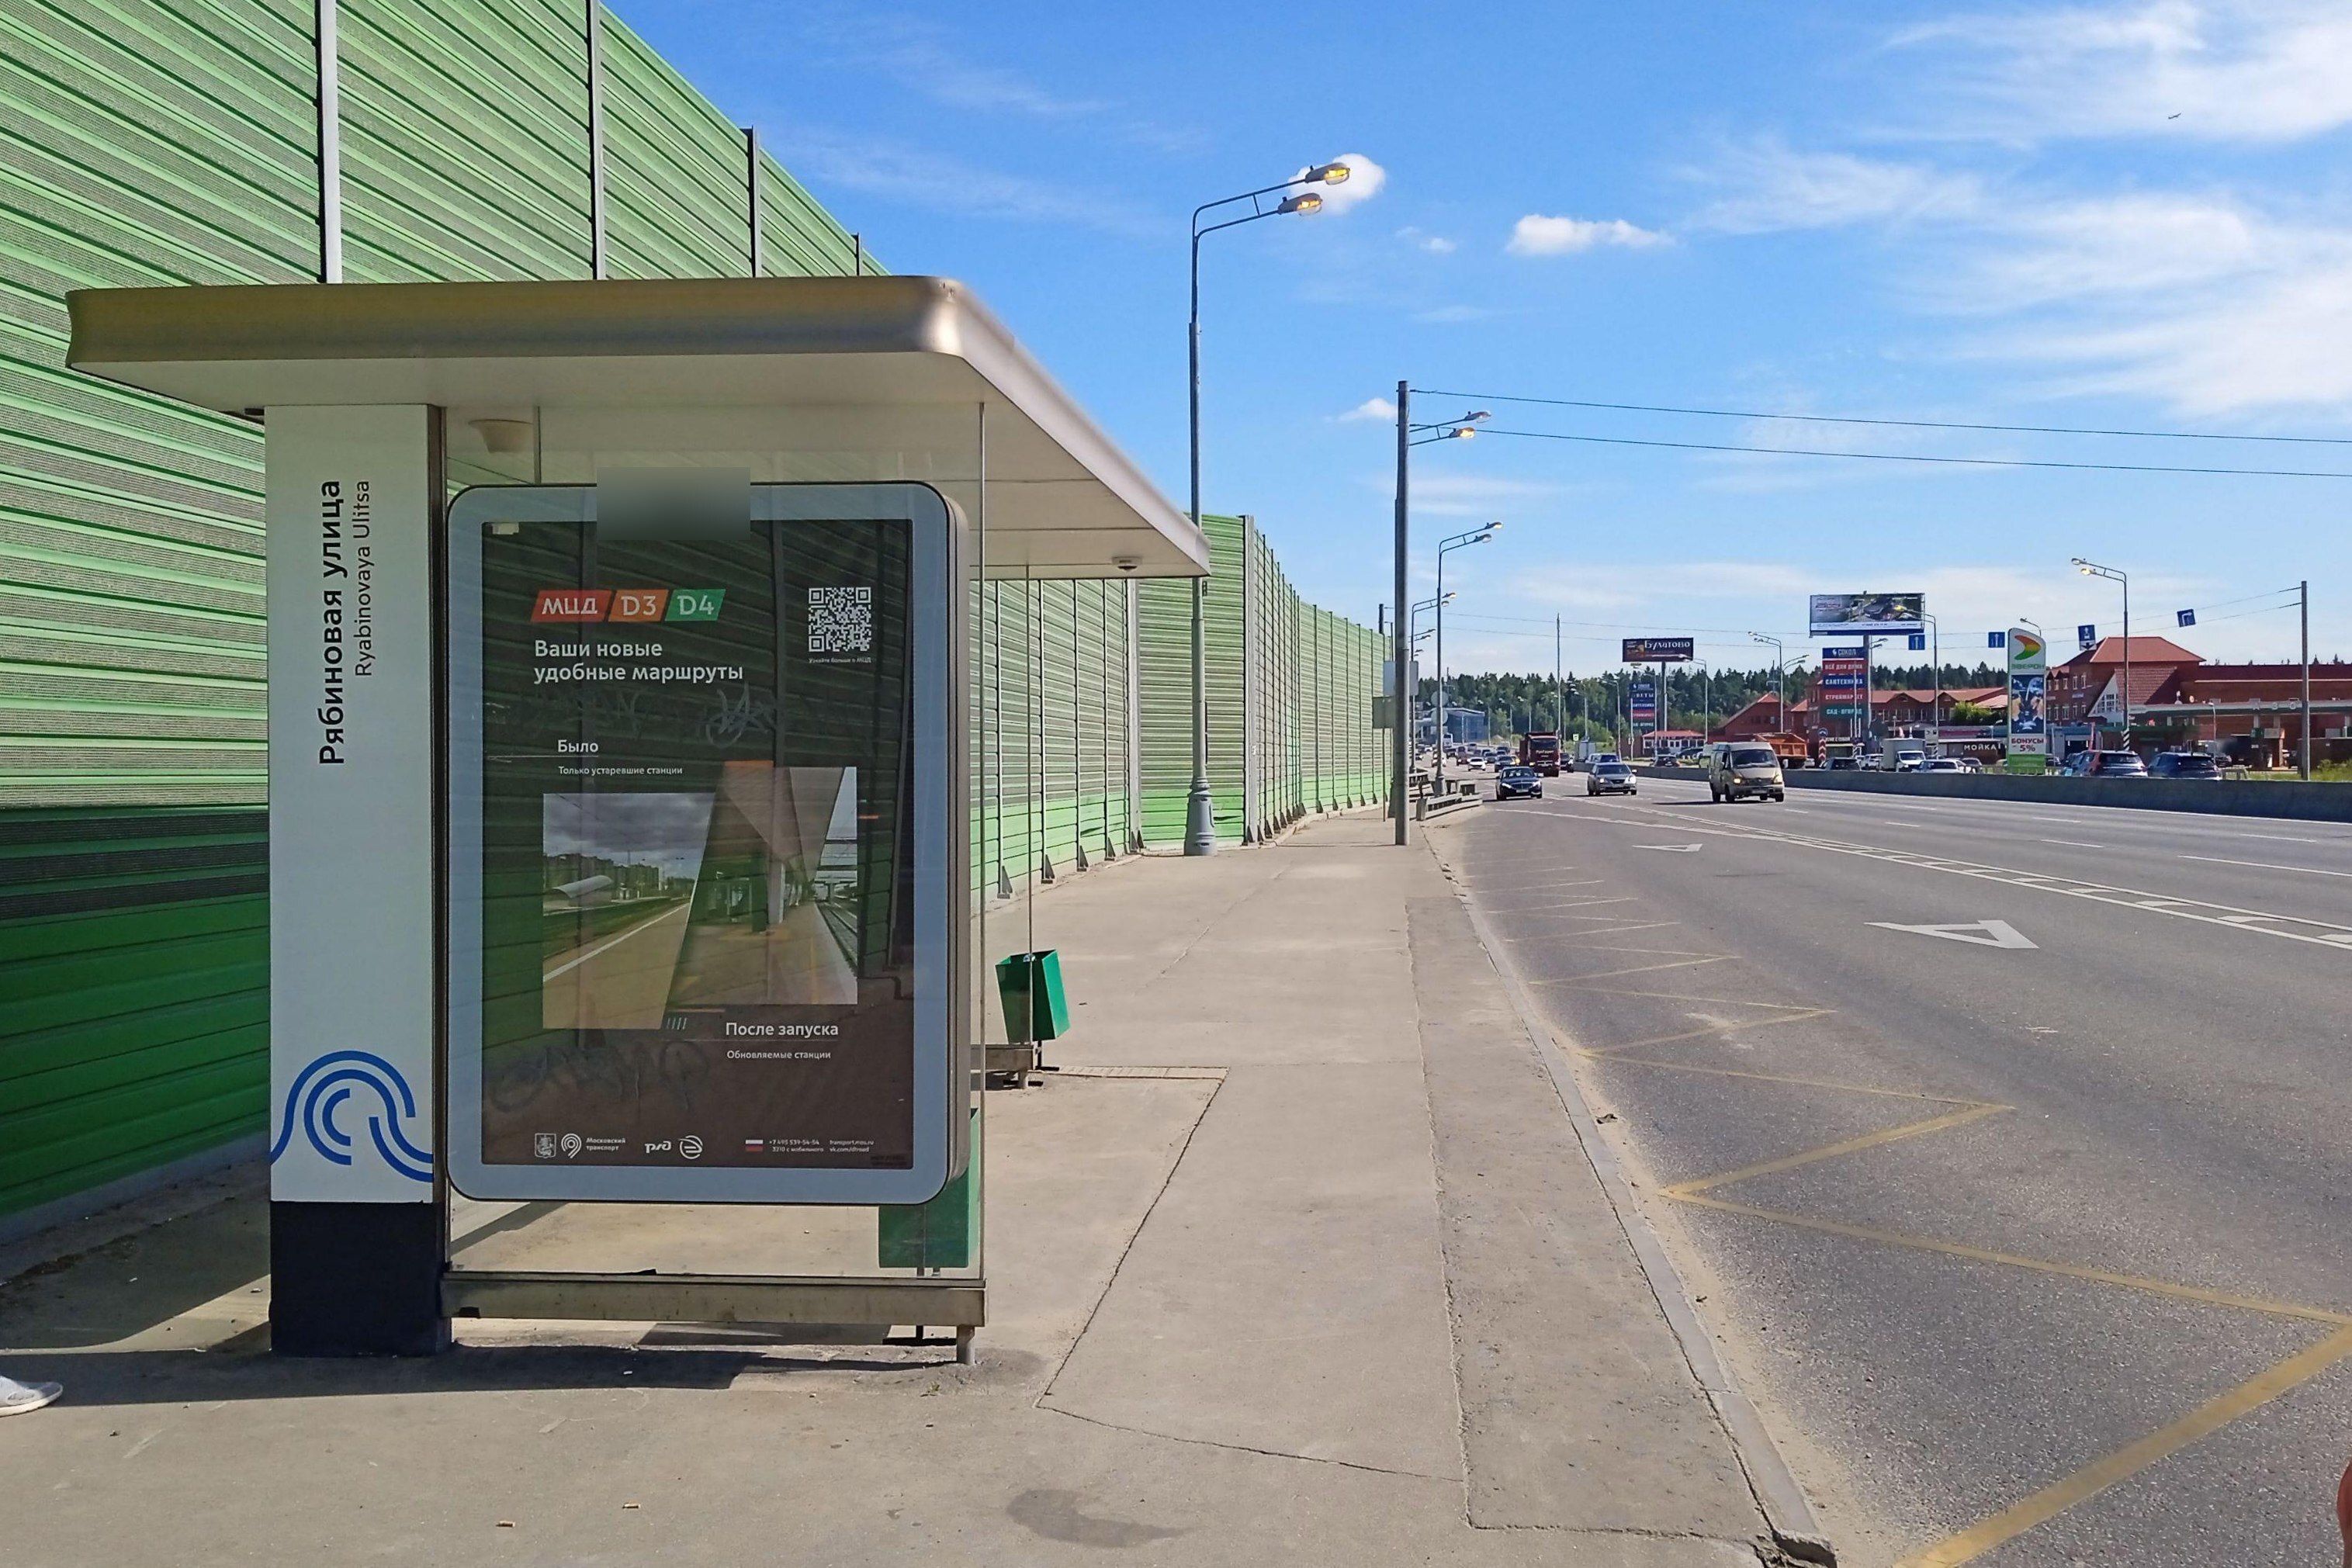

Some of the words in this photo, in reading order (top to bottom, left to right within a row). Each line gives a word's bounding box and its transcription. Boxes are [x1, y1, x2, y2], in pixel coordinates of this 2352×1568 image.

[352, 480, 370, 538] Ulitsa
[321, 480, 348, 578] улица
[353, 545, 376, 677] Ryabinovaya
[542, 597, 598, 615] МЦД
[621, 596, 657, 616] D3
[677, 595, 715, 615] D4
[535, 640, 591, 657] Ваши
[597, 642, 663, 657] новые
[1644, 640, 1691, 650] Булатово
[317, 590, 345, 764] Рябиновая
[534, 663, 626, 684] удобные
[632, 666, 743, 684] маршруты
[558, 739, 599, 753] Было
[559, 766, 590, 775] Только
[591, 767, 645, 776] устаревшие
[726, 1022, 774, 1036] После
[778, 1025, 839, 1038] запуска
[726, 1050, 792, 1059] Обновляемые
[794, 1051, 831, 1060] станции
